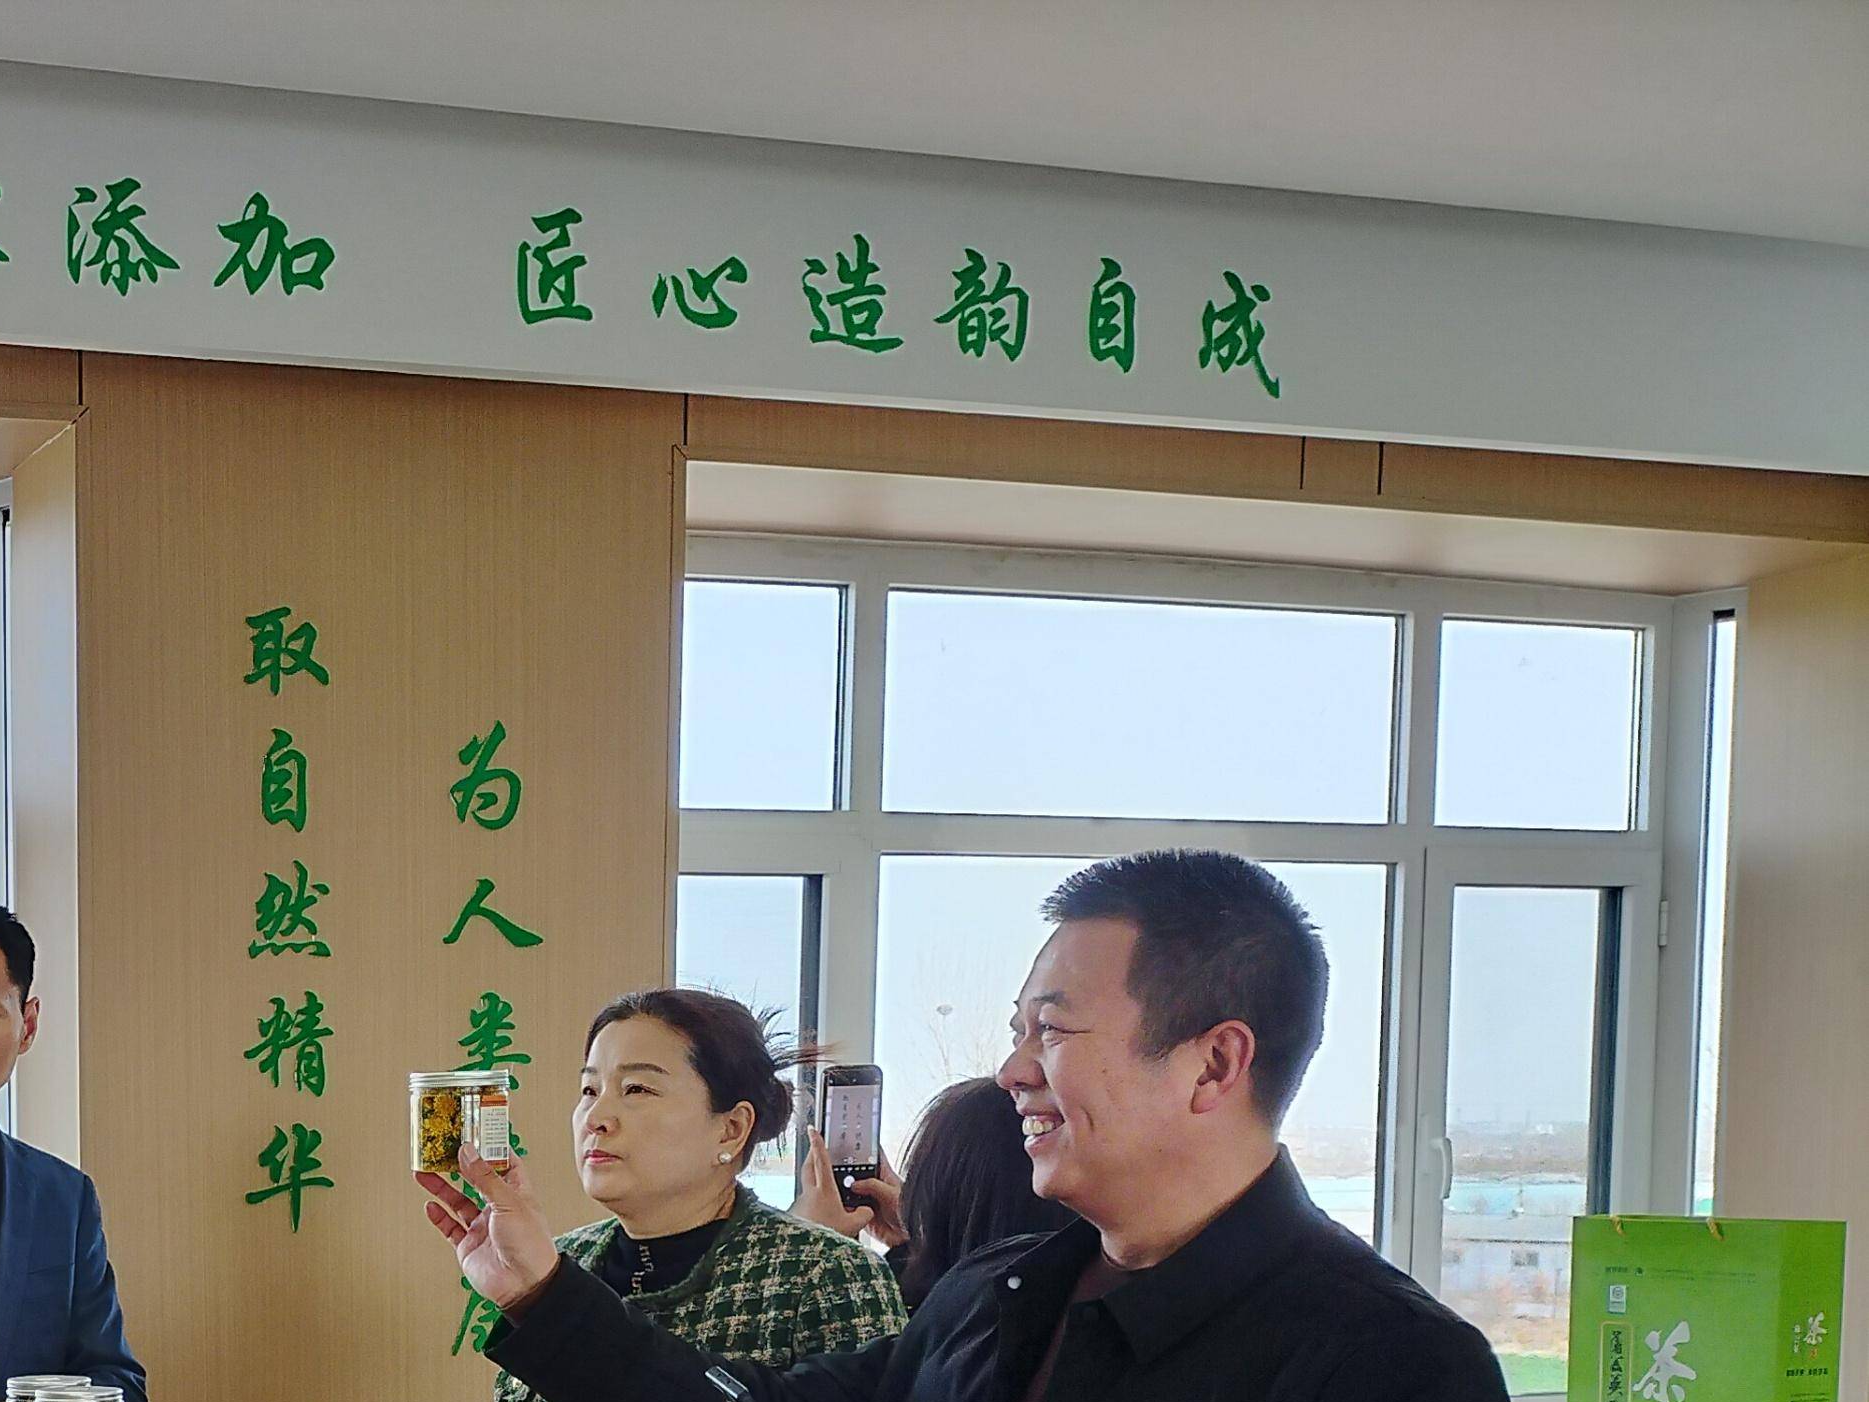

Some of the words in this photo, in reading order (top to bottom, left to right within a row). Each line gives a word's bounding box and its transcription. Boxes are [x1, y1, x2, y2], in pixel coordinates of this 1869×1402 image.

[516, 208, 1280, 399] 匠心造韵自成
[243, 607, 334, 1233] 取自然精华
[442, 719, 543, 1353] 为人类
